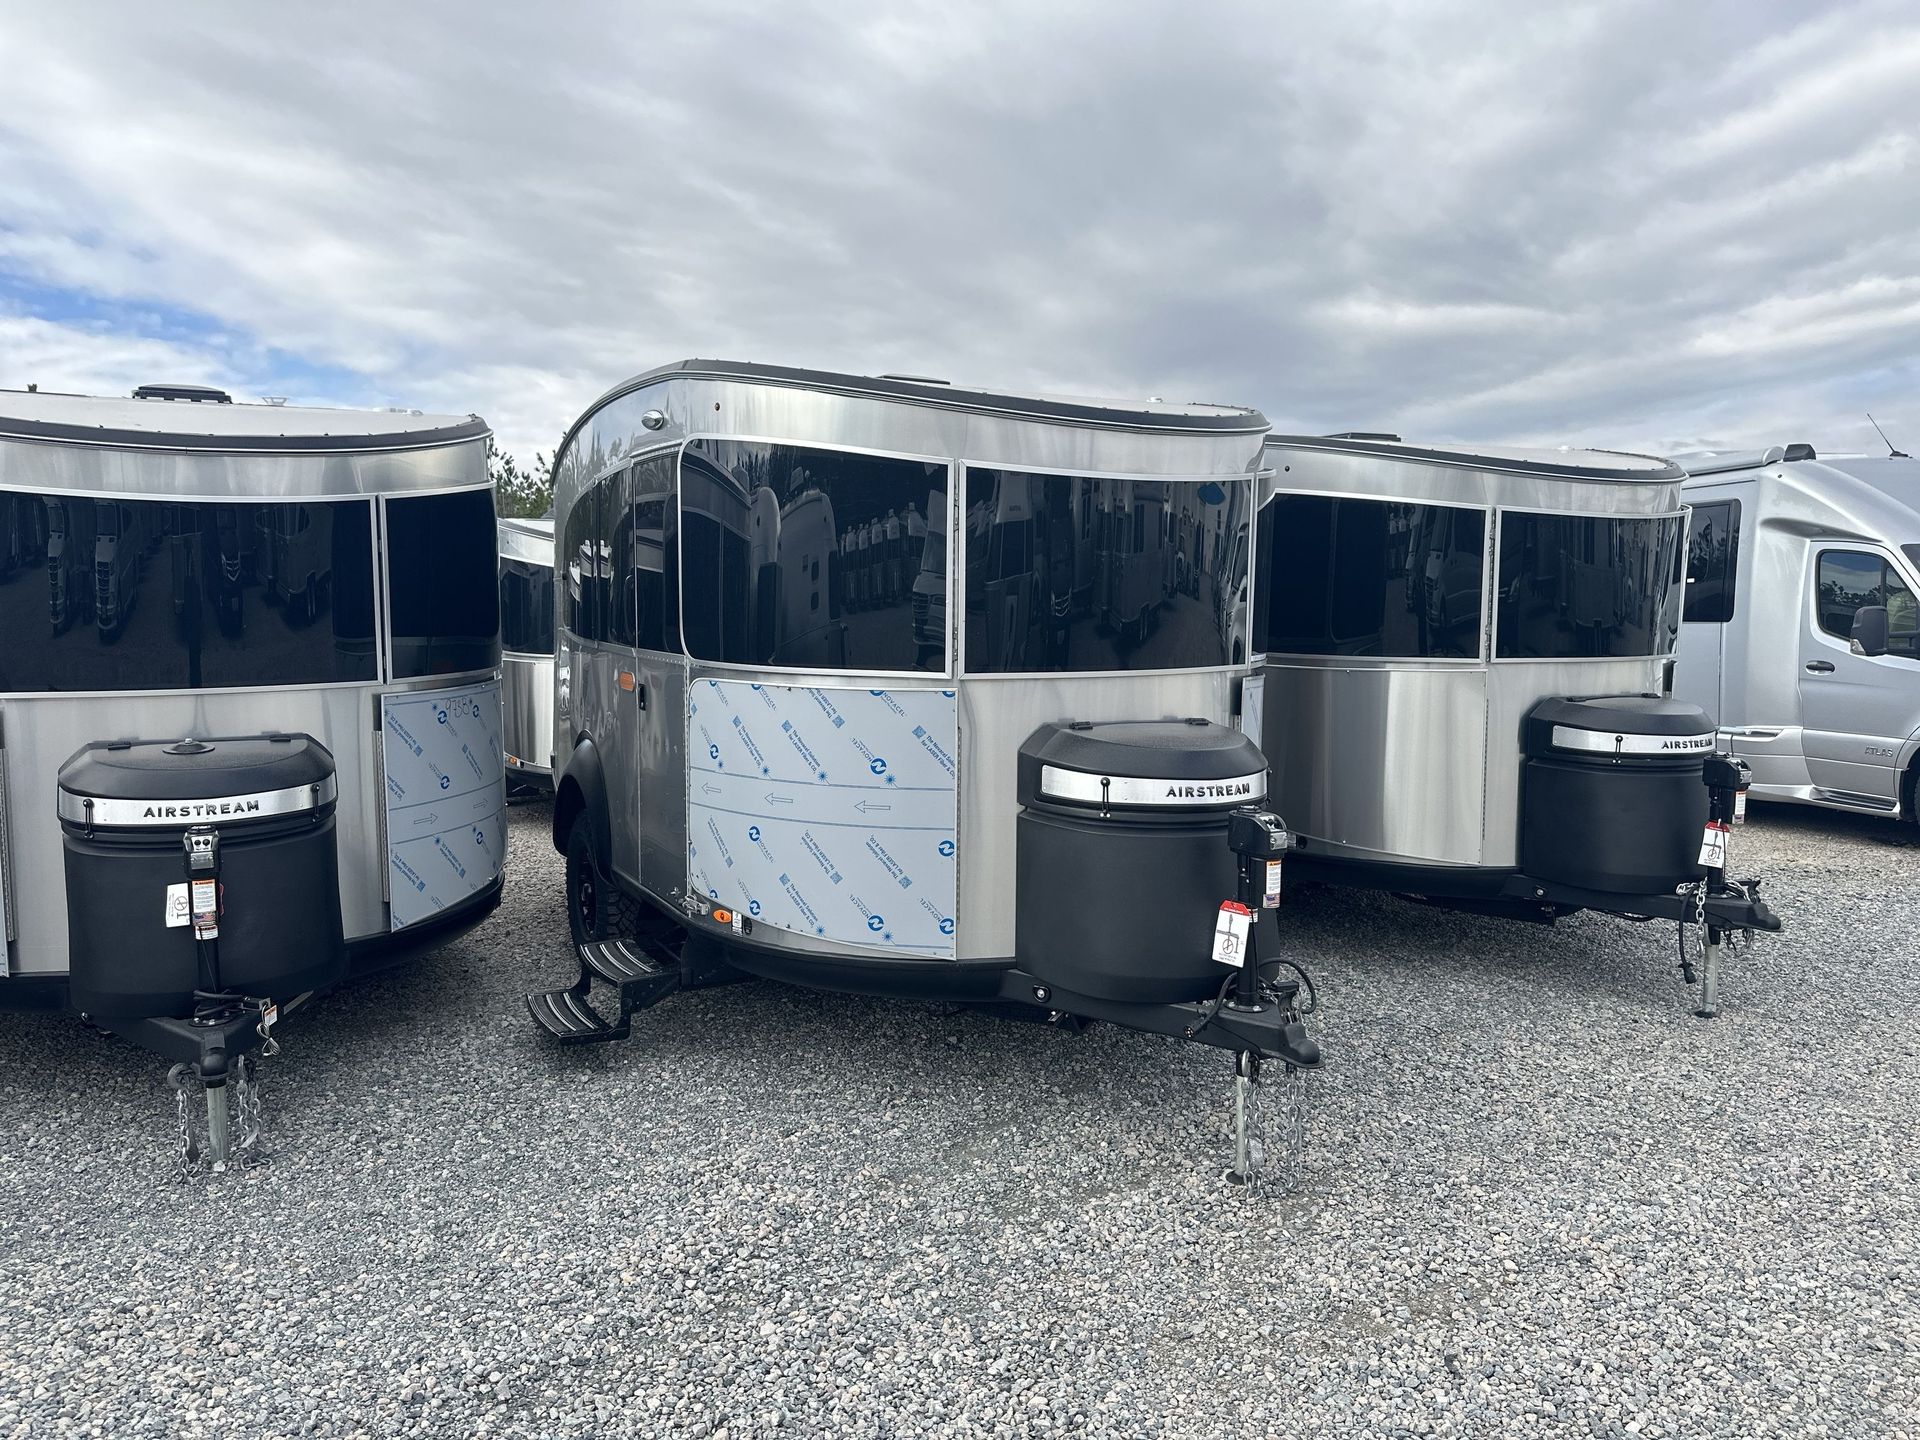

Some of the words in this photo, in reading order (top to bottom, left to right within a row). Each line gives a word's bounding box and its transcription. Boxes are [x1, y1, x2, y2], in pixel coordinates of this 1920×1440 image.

[883, 692, 905, 717] NOVACEL
[851, 738, 873, 763] NOVACEL
[1661, 738, 1713, 750] AIRSTREAM
[1864, 745, 1893, 757] ATLAS
[1166, 783, 1250, 797] AIRSTREAM
[143, 800, 260, 817] AIRSTREAM
[759, 839, 774, 863] NOVACEL
[849, 894, 870, 919] NOVACEL
[920, 898, 941, 922] NOVACEL
